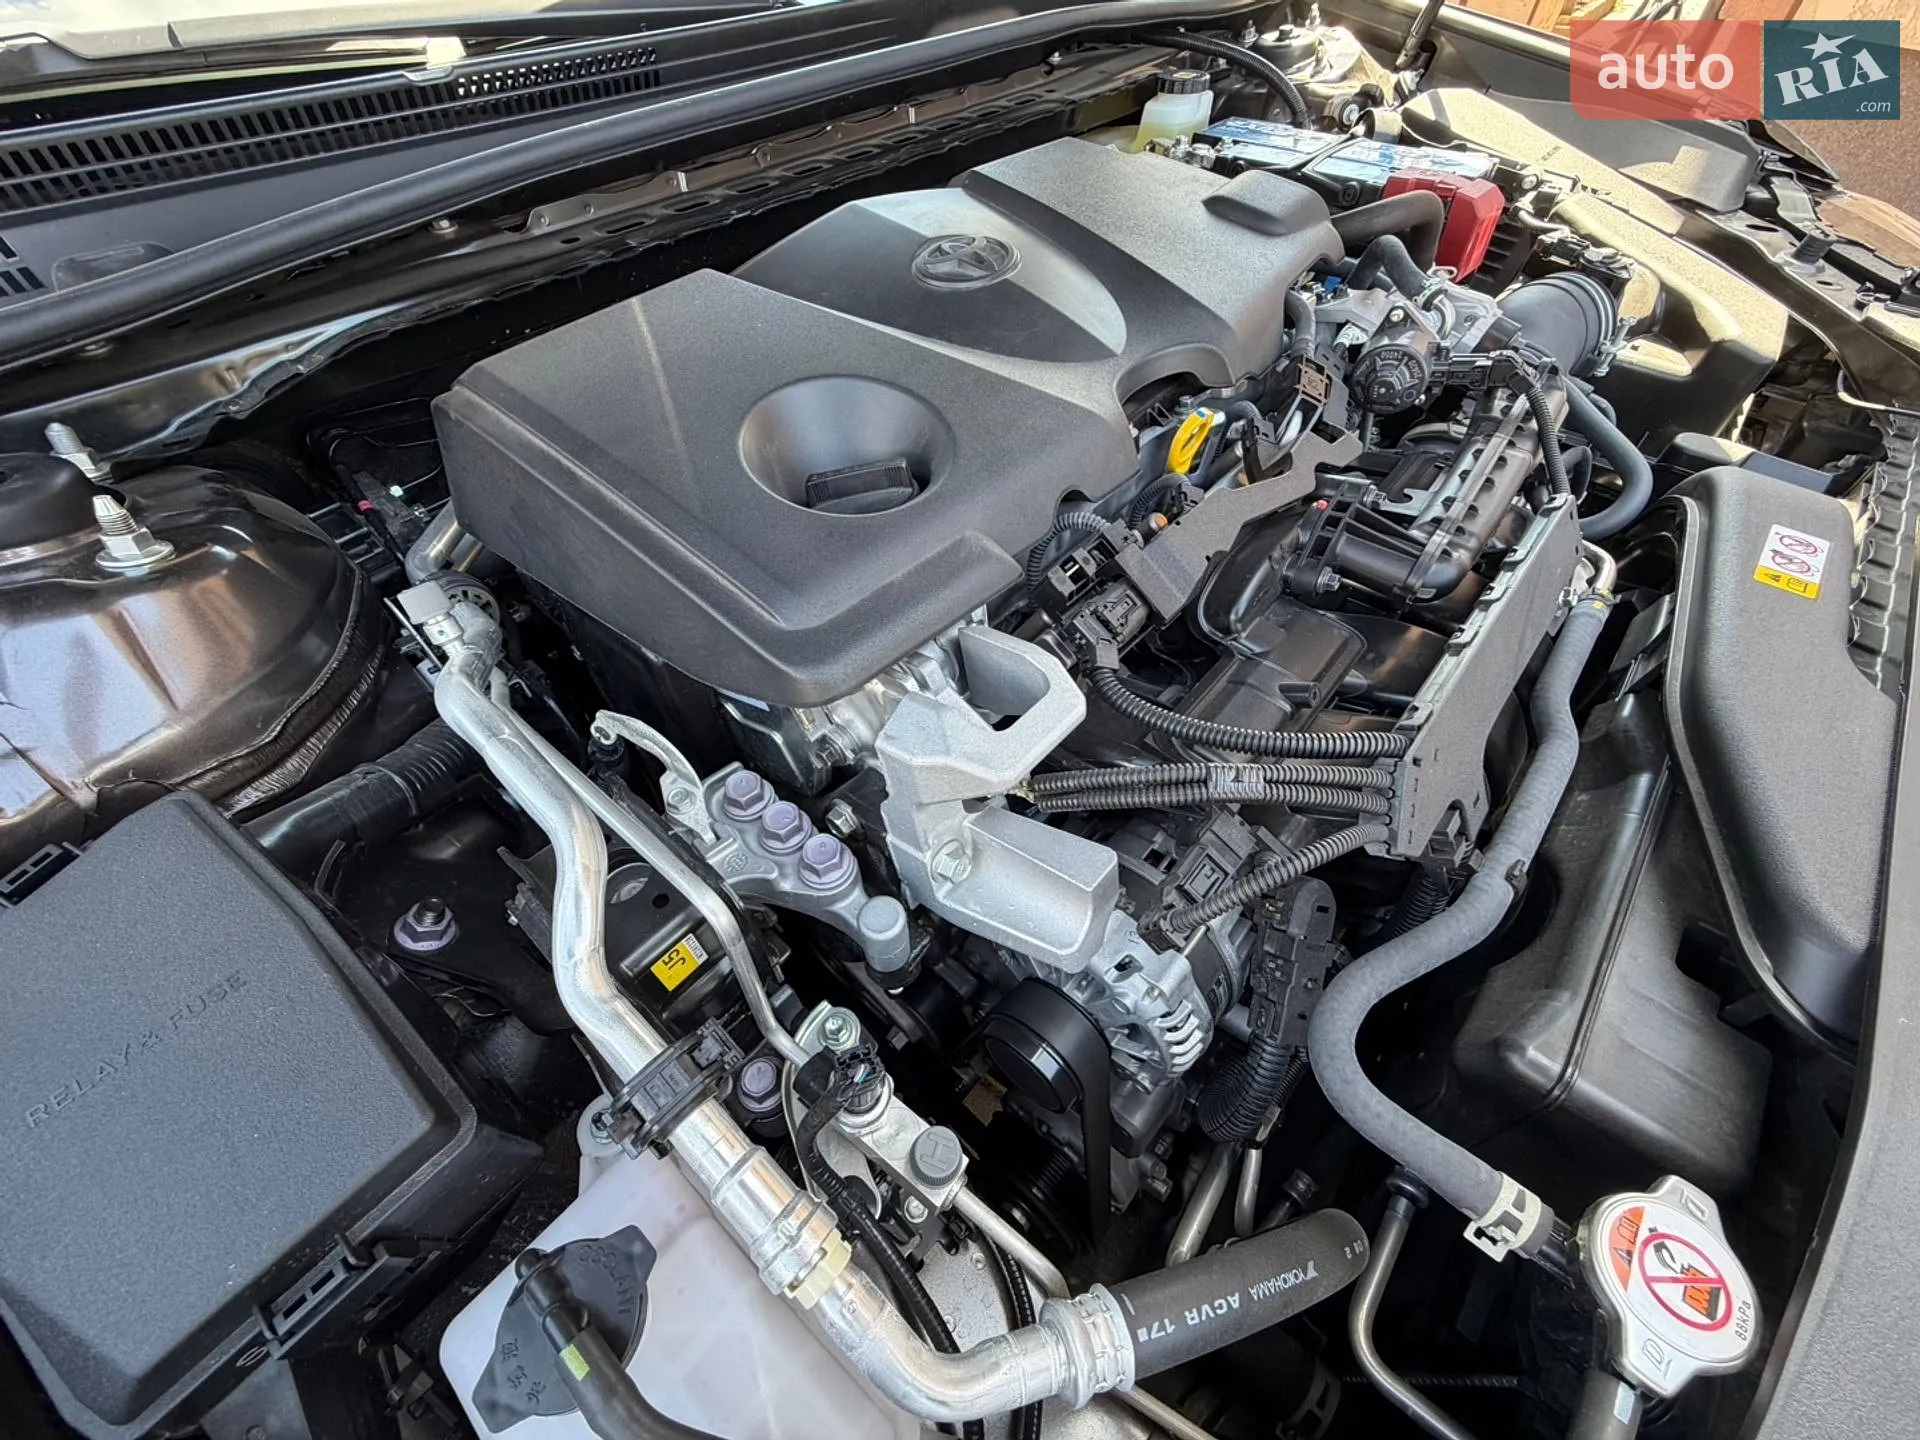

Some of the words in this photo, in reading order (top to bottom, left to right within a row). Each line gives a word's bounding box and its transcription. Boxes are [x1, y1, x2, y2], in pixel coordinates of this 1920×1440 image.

[26, 1042, 132, 1128] RELAY
[168, 970, 248, 1032] FUSE
[1248, 1265, 1307, 1301] YOKOHAMA
[1184, 1292, 1241, 1326] ACVR
[1734, 1300, 1753, 1341] 88kPa
